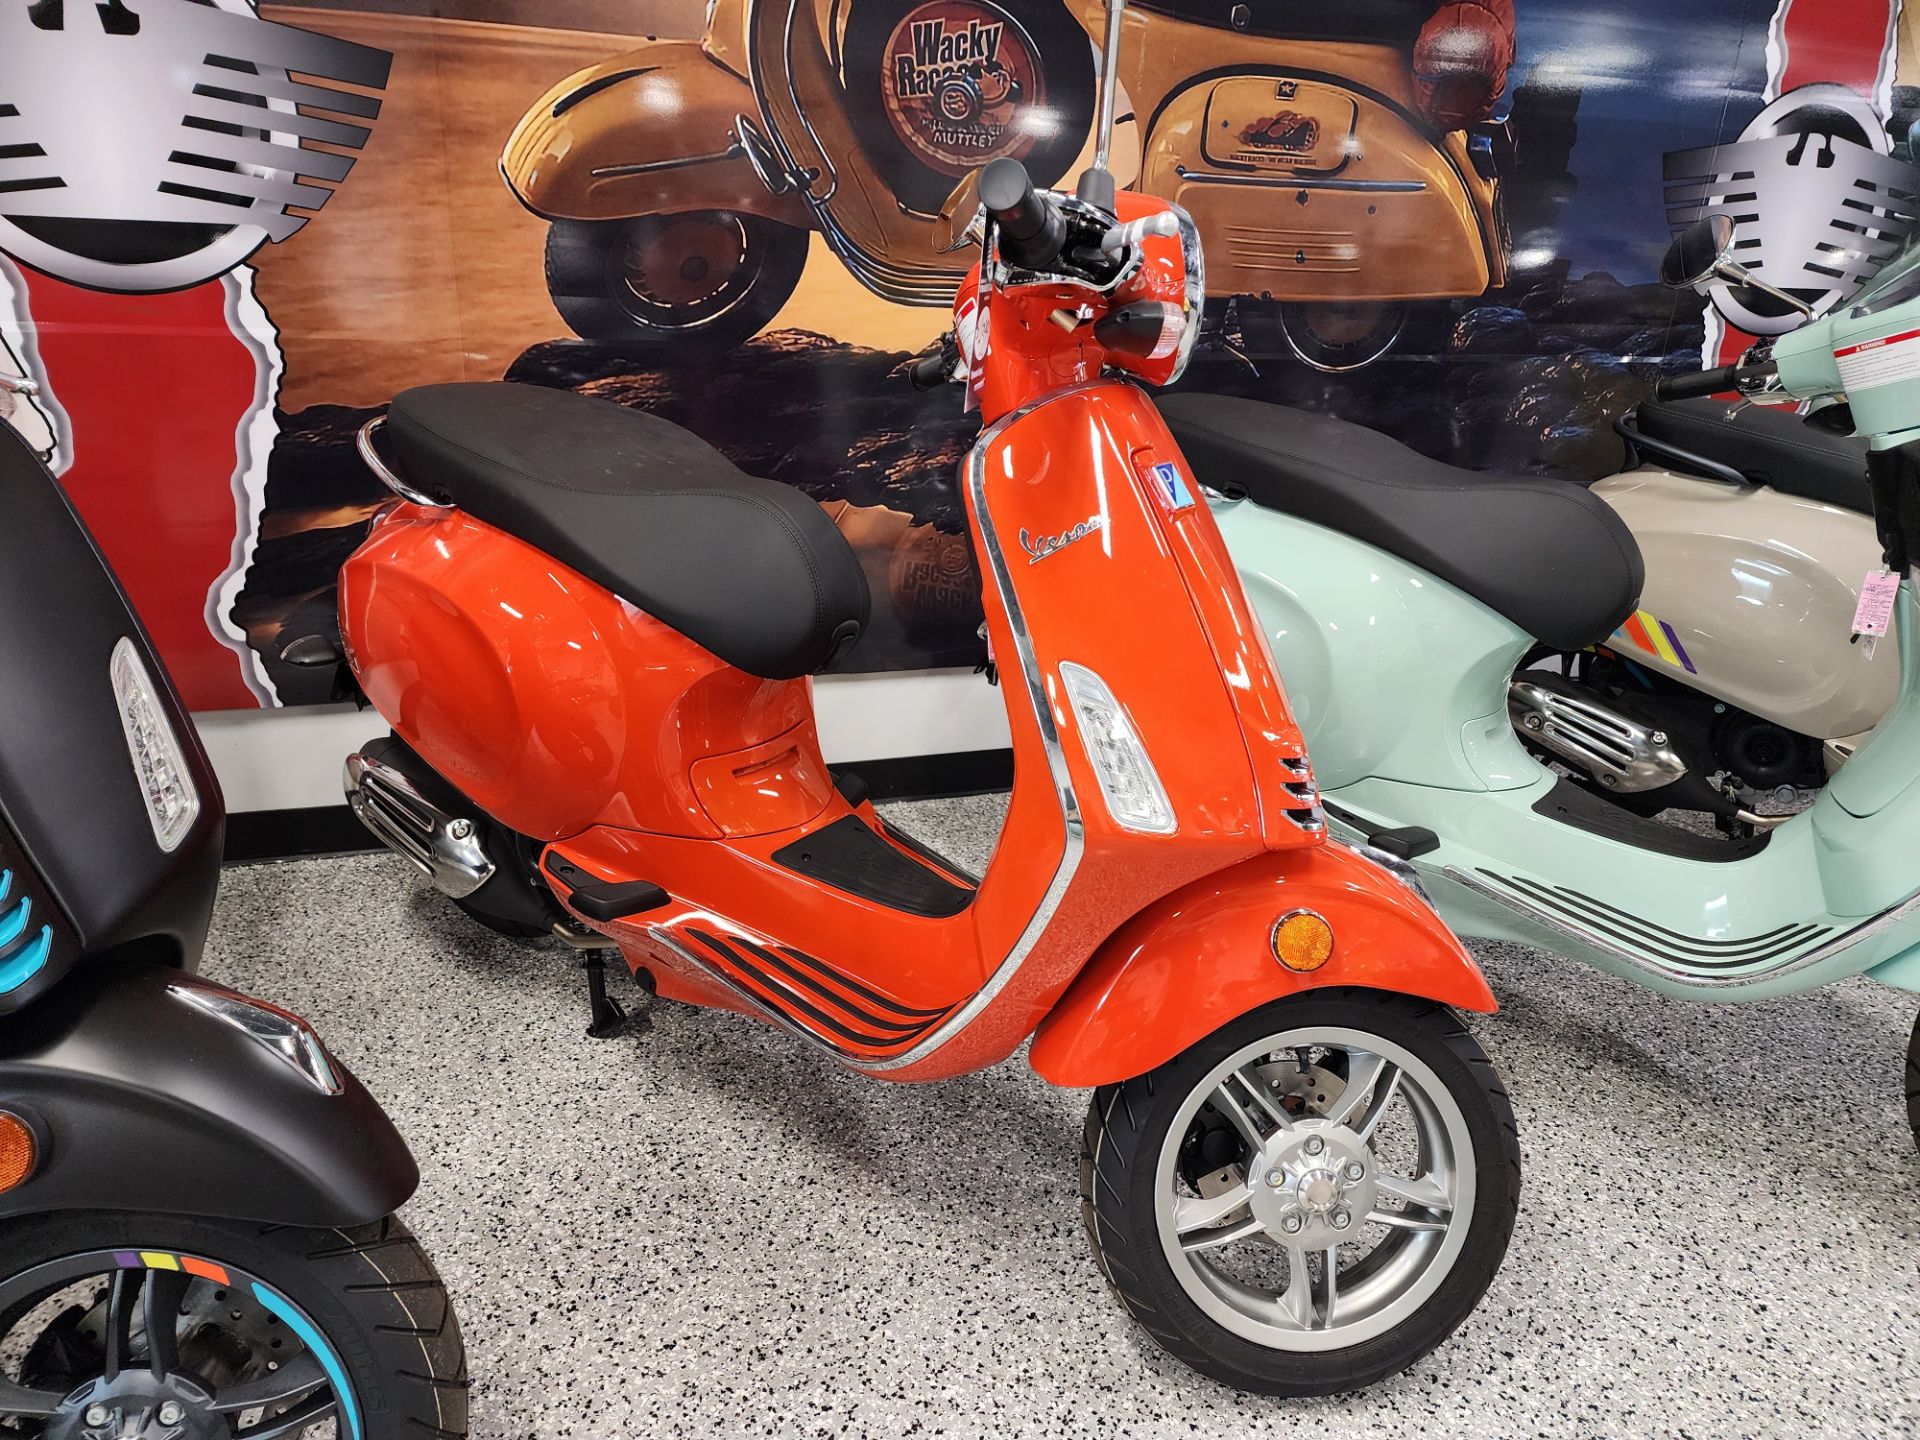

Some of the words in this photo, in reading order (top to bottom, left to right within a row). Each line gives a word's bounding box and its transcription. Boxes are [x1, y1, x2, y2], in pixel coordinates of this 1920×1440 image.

[911, 18, 1003, 66] Wacky
[933, 131, 998, 148] MUTTLEY
[1019, 513, 1108, 565] Vespa
